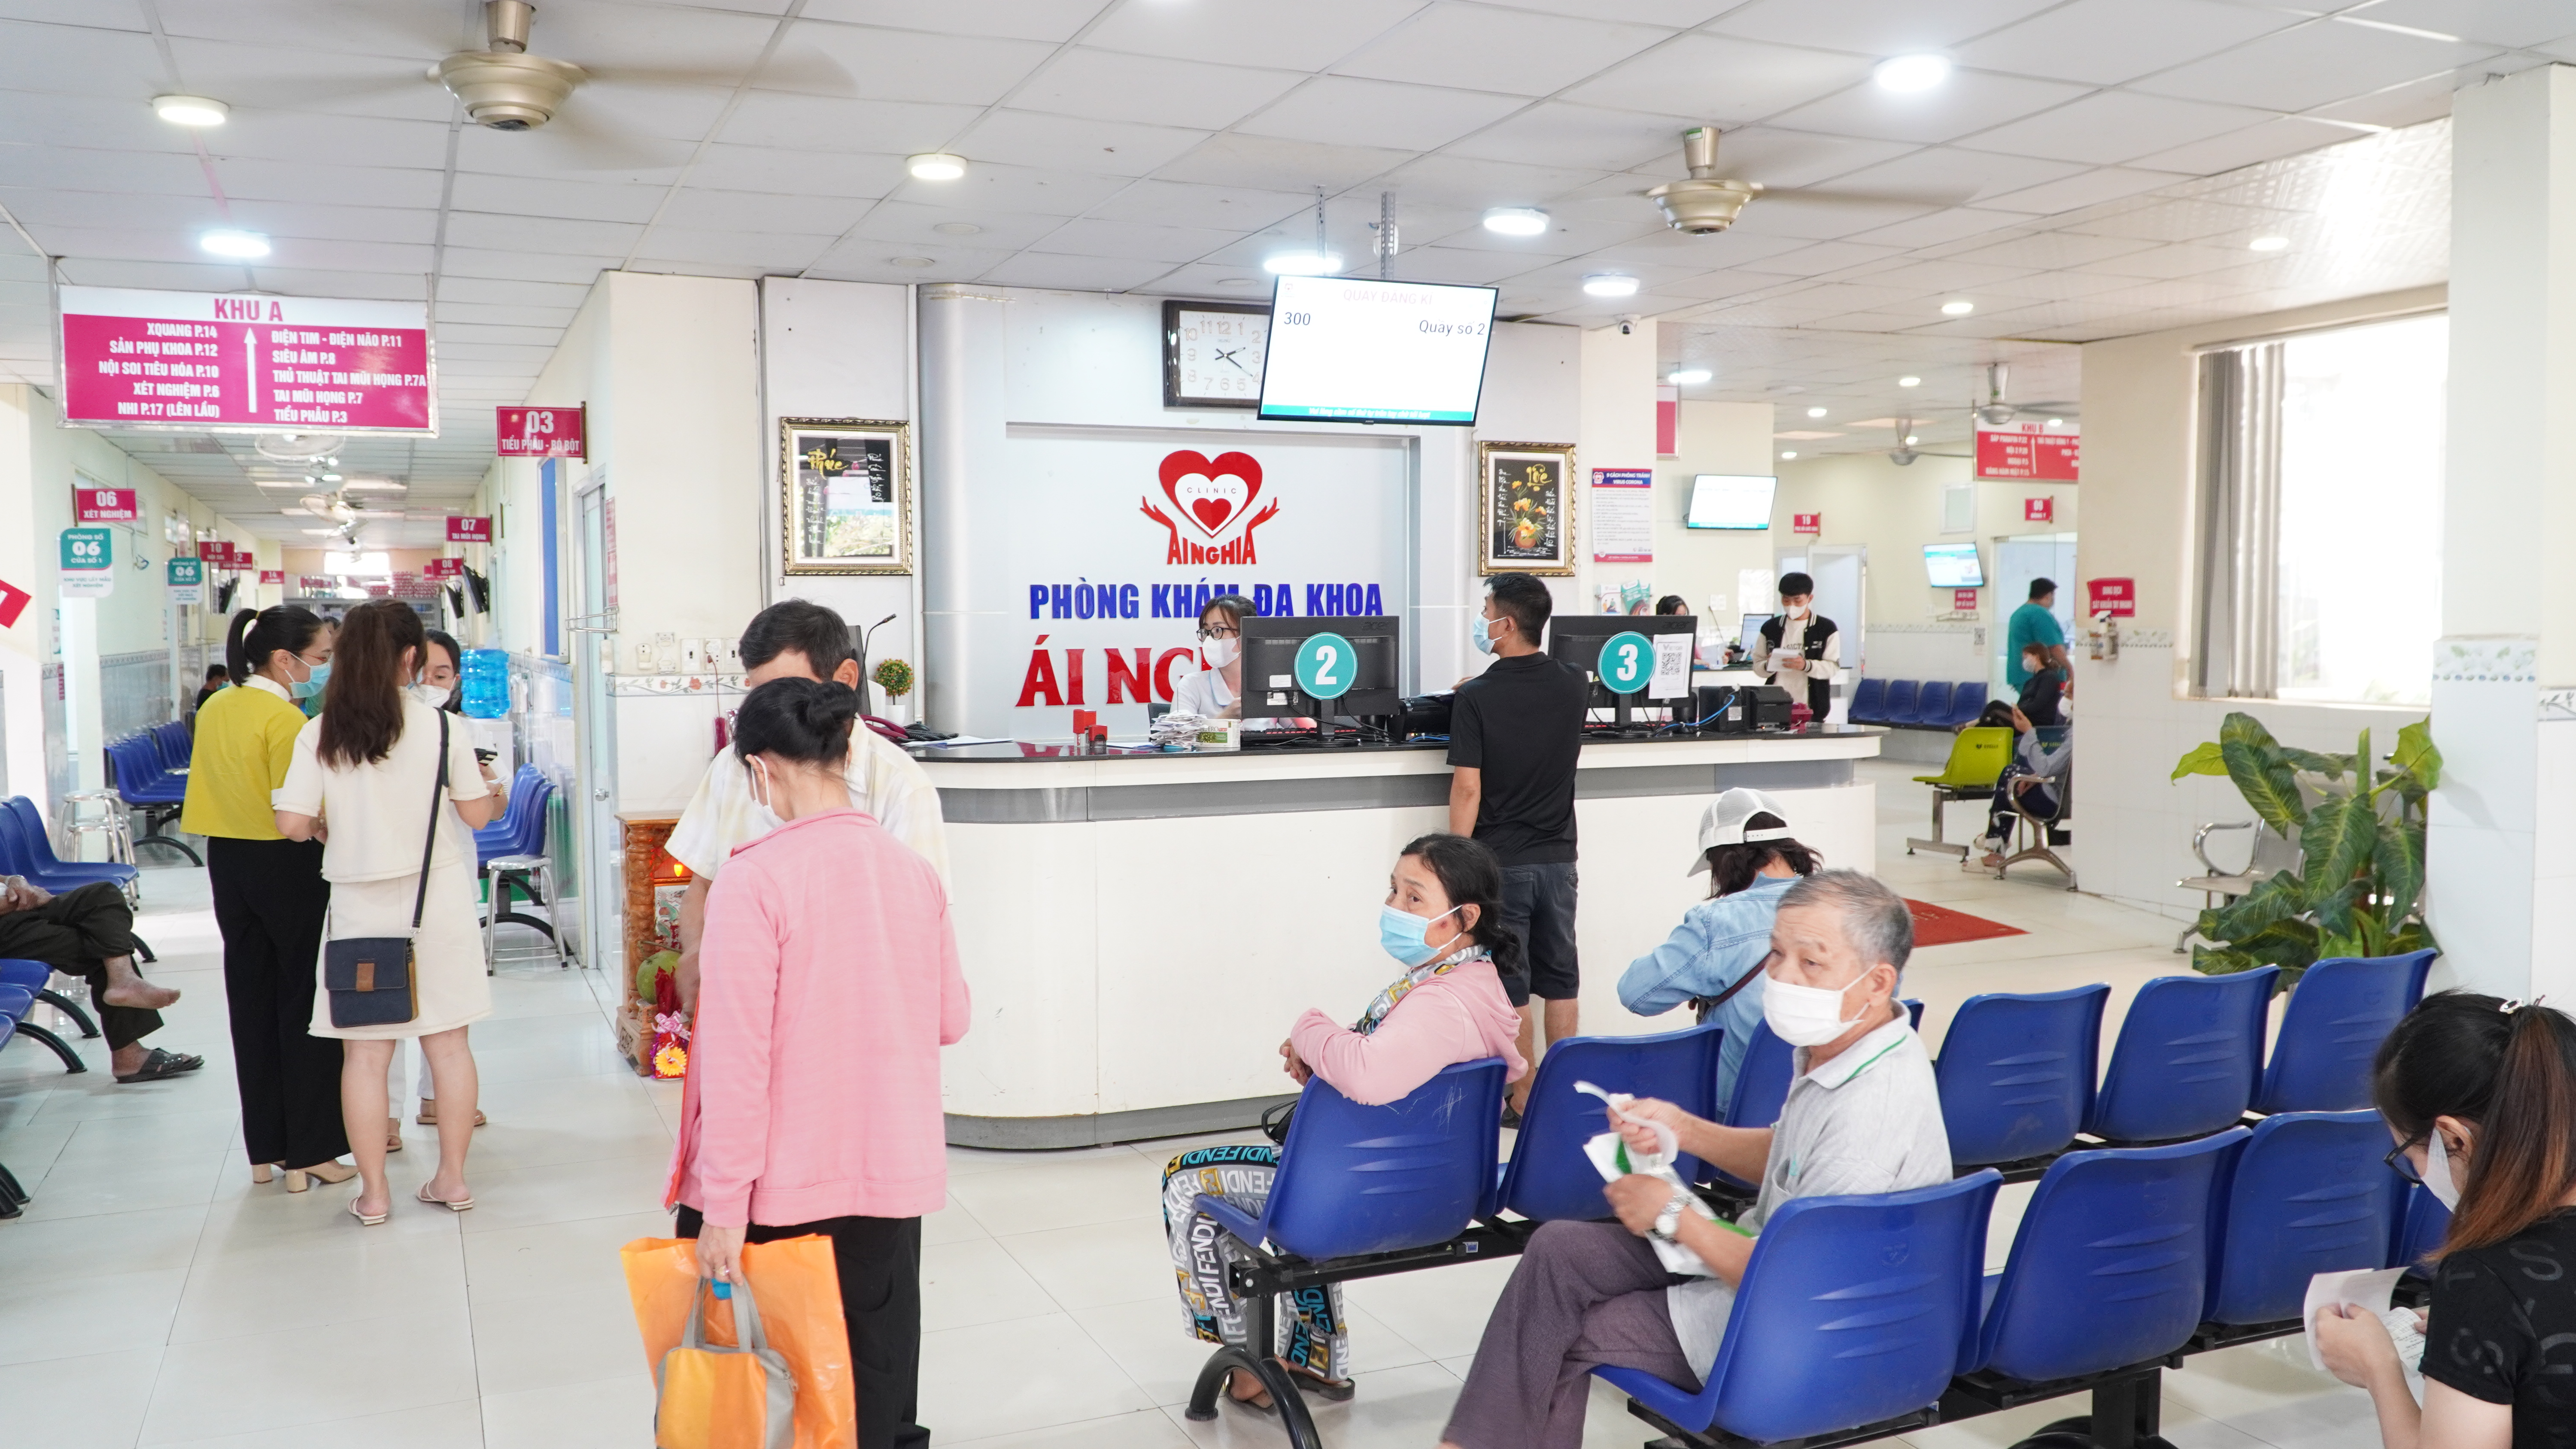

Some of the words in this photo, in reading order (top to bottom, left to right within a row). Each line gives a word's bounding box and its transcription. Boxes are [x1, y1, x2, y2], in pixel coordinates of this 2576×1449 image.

[214, 298, 260, 320] KHU
[269, 301, 283, 321] A
[1284, 312, 1311, 326] 300
[147, 322, 192, 337] XQUANG
[194, 324, 218, 338] P.14
[1185, 328, 1198, 341] 10
[1200, 321, 1212, 333] 11
[1217, 321, 1231, 335] 12
[1238, 322, 1243, 335] 1
[1457, 321, 1475, 335] số
[1477, 324, 1485, 335] 2
[271, 328, 298, 346] ĐIỆN
[300, 331, 319, 344] TIM
[329, 330, 355, 348] ĐIỆN
[357, 332, 379, 347] NÃO
[381, 335, 402, 347] P.11
[1252, 330, 1261, 343] 2
[109, 337, 133, 354] SẢN
[136, 342, 159, 358] PHỤ
[162, 343, 192, 355] KHOA
[194, 343, 218, 357] P.12
[1187, 349, 1197, 361] 9
[272, 348, 297, 364] SIÊU
[300, 349, 318, 364] ÂM
[320, 352, 336, 365] P.8
[1252, 351, 1261, 364] 3
[99, 359, 119, 376] NỘI
[122, 362, 141, 375] SOI
[143, 361, 168, 376] TIÊU
[170, 362, 194, 377] HÓA
[196, 365, 219, 378] P.10
[1188, 370, 1196, 382] 8
[273, 367, 295, 383] THỦ
[296, 369, 329, 386] THUẬT
[332, 372, 347, 385] TAI
[349, 371, 371, 385] MŨI
[373, 373, 402, 388] HỌNG
[404, 374, 426, 387] P.7A
[1204, 377, 1214, 390] 7
[1220, 378, 1230, 391] 6
[1237, 378, 1246, 391] 5
[1252, 372, 1261, 385] 4
[133, 380, 154, 395] XÉT
[157, 382, 200, 399] NGHIỆM
[203, 385, 220, 398] P.6
[273, 390, 289, 403] TAI
[292, 388, 313, 403] MŨI
[316, 391, 345, 406] HỌNG
[347, 392, 363, 404] P.7
[118, 402, 138, 415] NHI
[140, 402, 163, 415] P.17
[167, 401, 193, 417] (LÊN
[274, 404, 298, 421] TIỂU
[301, 406, 330, 422] PHẪU
[331, 411, 348, 423] P.3
[526, 411, 554, 433] 03
[2022, 423, 2037, 433] KHU
[501, 434, 519, 450] TIỂU
[521, 435, 544, 450] PHẪU
[551, 437, 562, 451] BÓ
[564, 438, 580, 453] BỘT
[96, 491, 117, 507] 06
[83, 509, 98, 518] XÉT
[100, 509, 132, 520] NGHIỆM
[461, 518, 476, 531] 07
[72, 541, 101, 556] 06
[210, 543, 222, 553] 10
[1167, 534, 1257, 564] AINGHIA
[175, 566, 194, 576] 06
[442, 560, 453, 568] 08
[1030, 577, 1139, 619] PHÒNG
[1253, 584, 1294, 616] ĐA
[1306, 583, 1383, 616] KHOA
[1015, 634, 1085, 707] ÁI
[1315, 645, 1337, 685] 2
[1616, 644, 1638, 682] 3
[1191, 1217, 1219, 1274] FENDI
